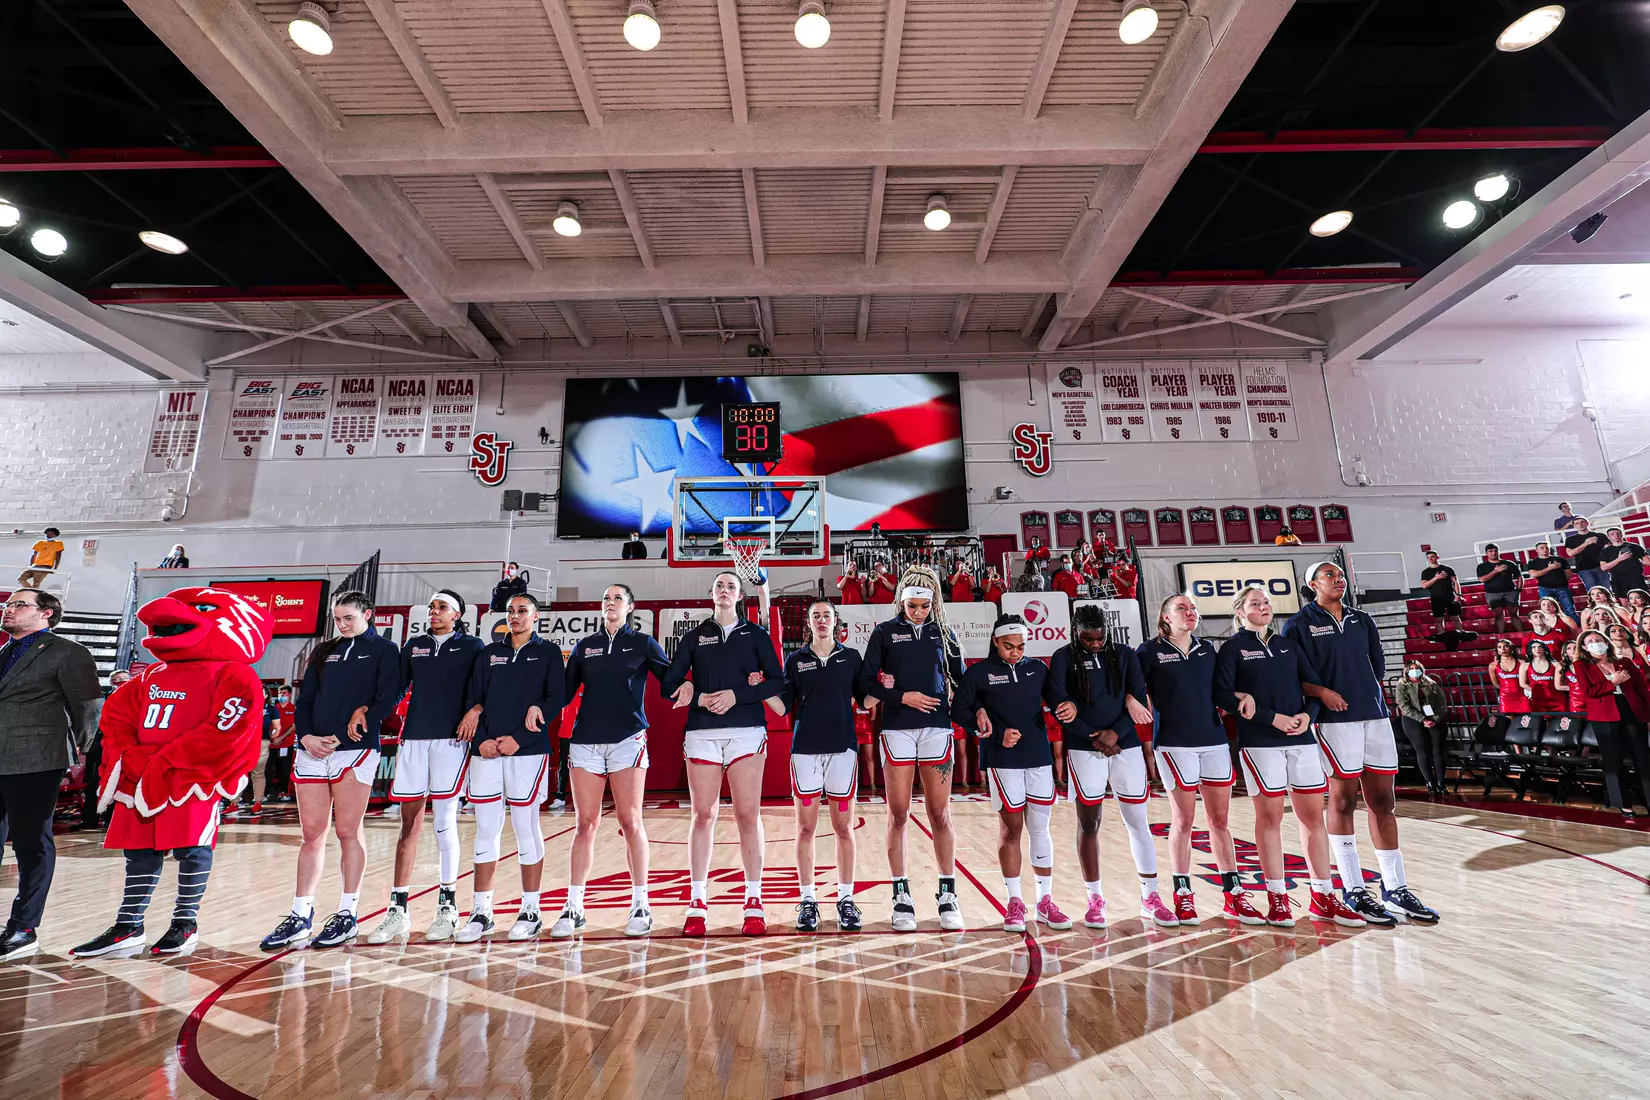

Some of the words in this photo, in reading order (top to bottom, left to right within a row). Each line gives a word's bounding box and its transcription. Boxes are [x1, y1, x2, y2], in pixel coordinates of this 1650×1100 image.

[1254, 367, 1276, 375] HELMS
[1103, 375, 1137, 388] COACH
[1151, 375, 1186, 386] PLAYER
[1200, 374, 1235, 385] PLAYER
[1246, 376, 1286, 385] FOUNDATION
[341, 378, 374, 393] NCAA
[388, 380, 426, 396] NCAA
[436, 379, 474, 396] NCAA
[1214, 386, 1237, 396] YEAR
[1247, 385, 1287, 393] CHAMPIONS
[1117, 388, 1139, 398] YEAR
[1165, 387, 1188, 396] YEAR
[168, 392, 196, 412] NIT
[433, 406, 450, 414] ELITE
[453, 405, 473, 413] EIGHT
[734, 408, 775, 422] 10:00
[283, 412, 326, 420] CHAMPIONS
[1106, 417, 1122, 425] 1983
[1128, 416, 1144, 424] 1985
[1166, 417, 1182, 425] 1985
[1257, 413, 1286, 422] 1910-11
[736, 425, 768, 451] 30
[375, 616, 391, 624] MILK
[538, 616, 641, 633] EACHS
[1027, 627, 1067, 640] erox
[1113, 627, 1130, 645] ATE
[143, 704, 174, 728] 01
